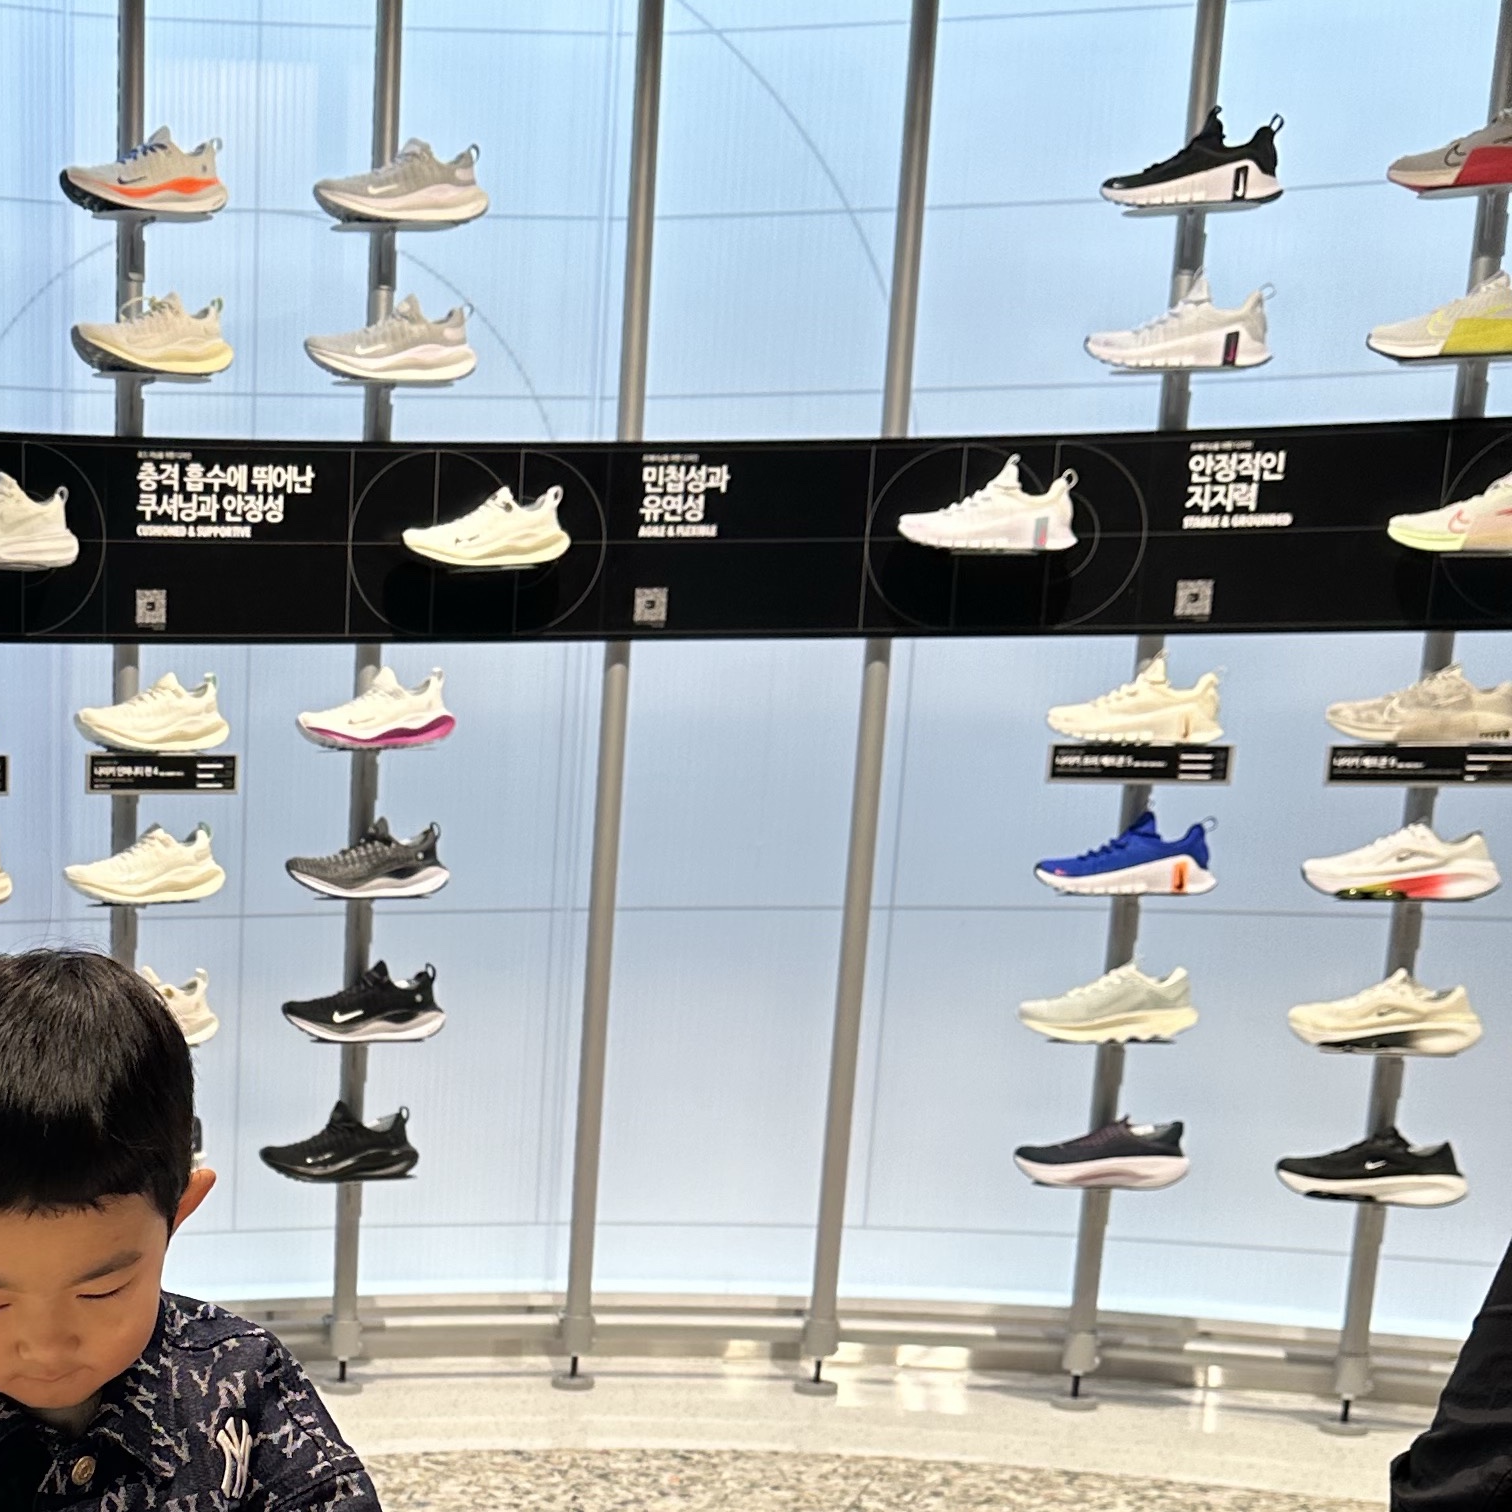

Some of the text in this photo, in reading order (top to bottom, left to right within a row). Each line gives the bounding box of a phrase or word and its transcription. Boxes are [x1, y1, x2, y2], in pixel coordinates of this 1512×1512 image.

[136, 462, 315, 494] 충격 흡수에 뛰어난
[642, 464, 731, 493] 민첩성과
[1188, 450, 1287, 483] 안정적인
[136, 493, 285, 523] 쿠셔닝과 안정성
[639, 494, 705, 522] 유연성
[1184, 482, 1259, 513] 지지력
